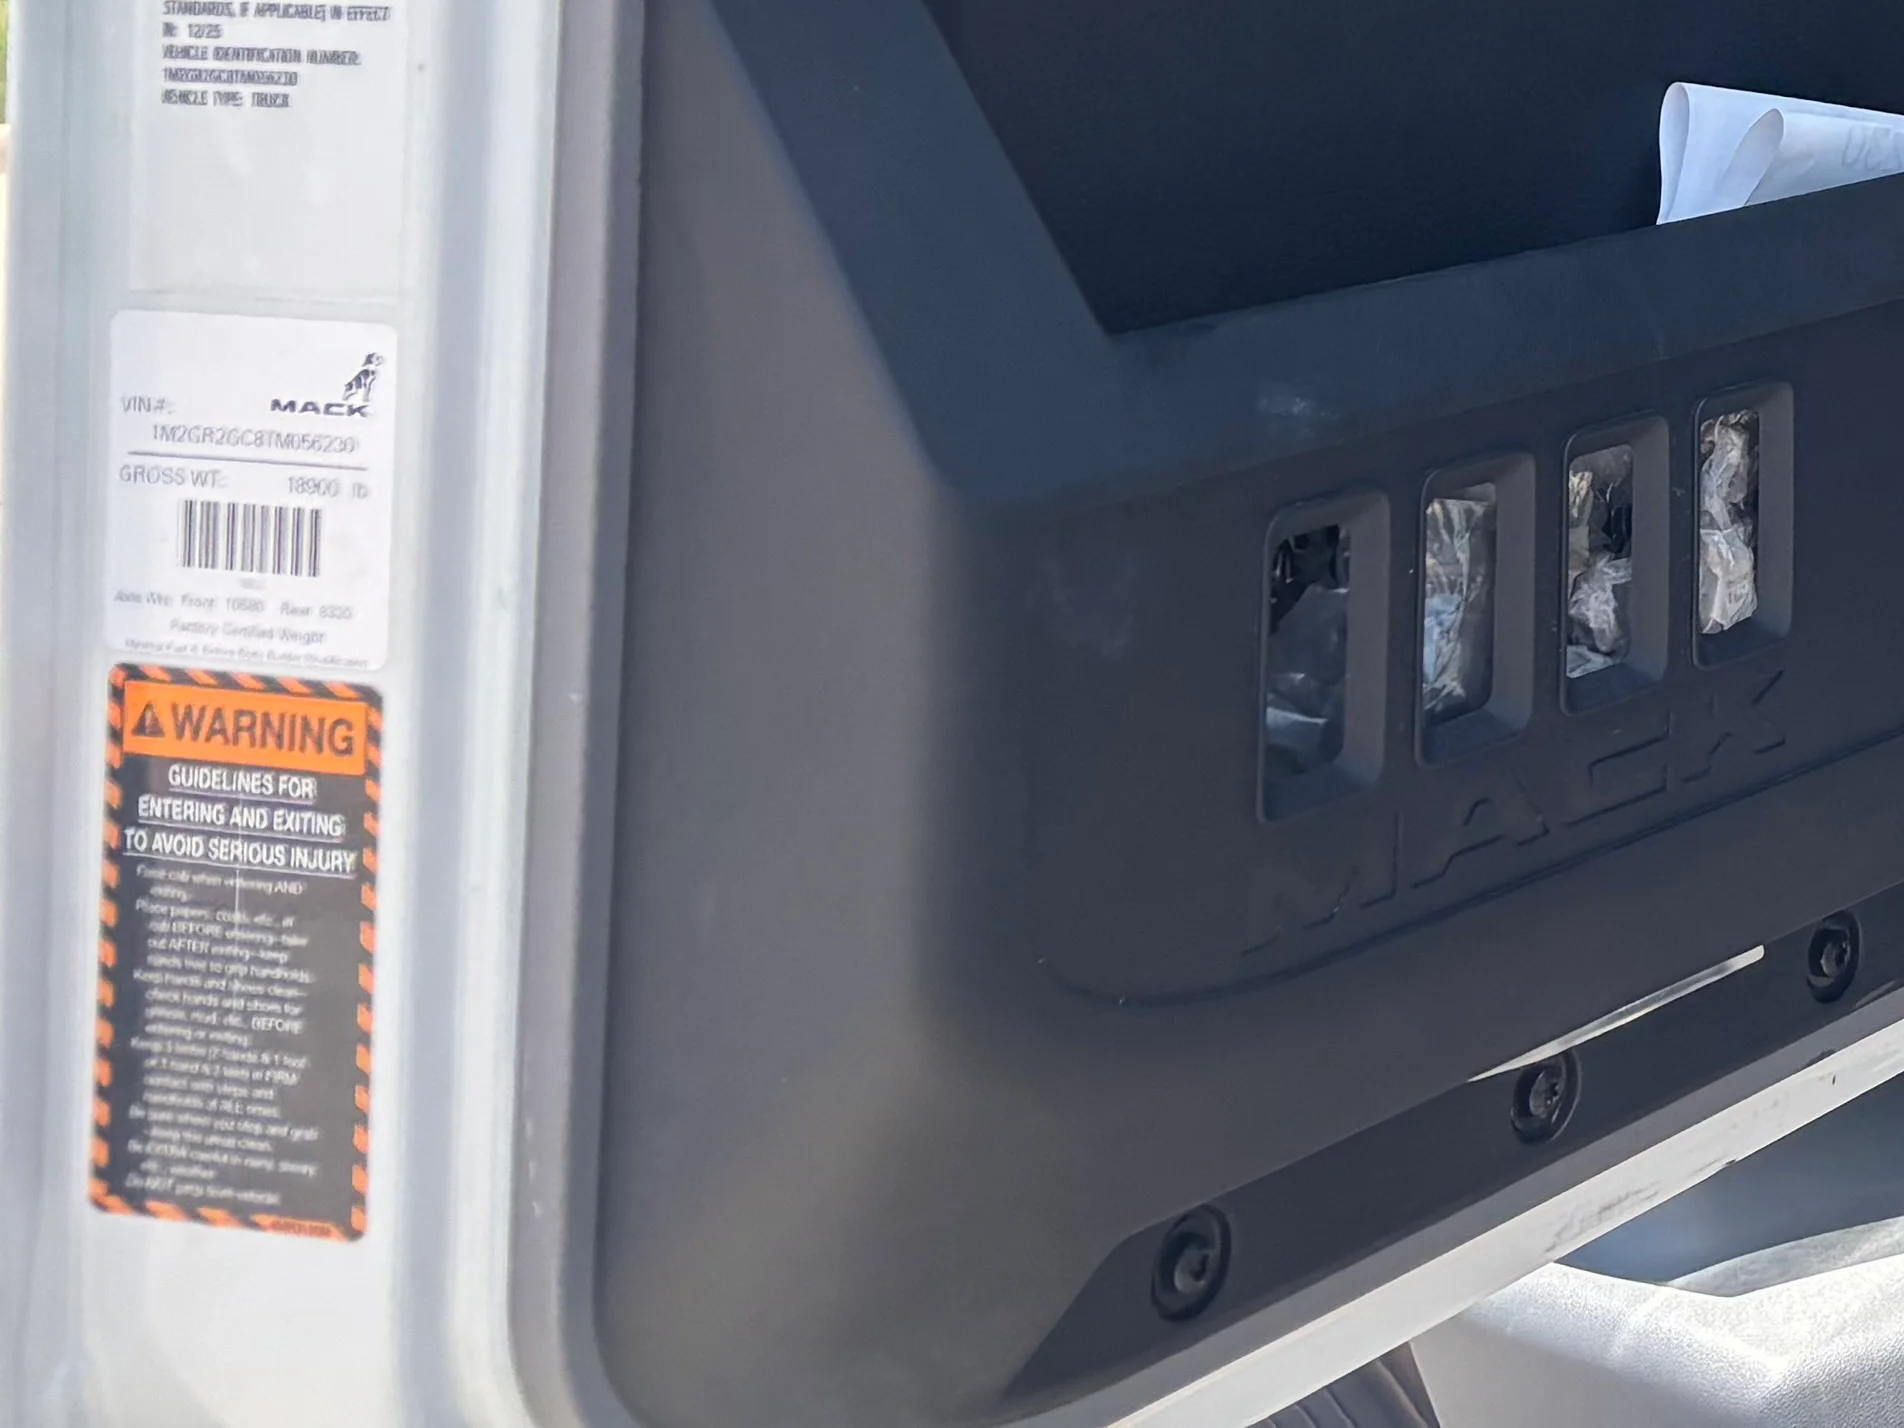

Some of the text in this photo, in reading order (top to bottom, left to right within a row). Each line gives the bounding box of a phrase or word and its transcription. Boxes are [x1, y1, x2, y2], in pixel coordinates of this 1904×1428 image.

[271, 398, 369, 418] MACK
[119, 464, 186, 485] GROSS
[288, 476, 340, 497] 18900
[352, 482, 371, 499] lb
[170, 702, 355, 757] WARNING
[168, 764, 316, 801] GUIDELINES FOR
[137, 795, 346, 837] ENTERING AND EXITING
[1240, 669, 1787, 956] MACK
[124, 827, 359, 873] TO AVOID SERIOUS INJURY
